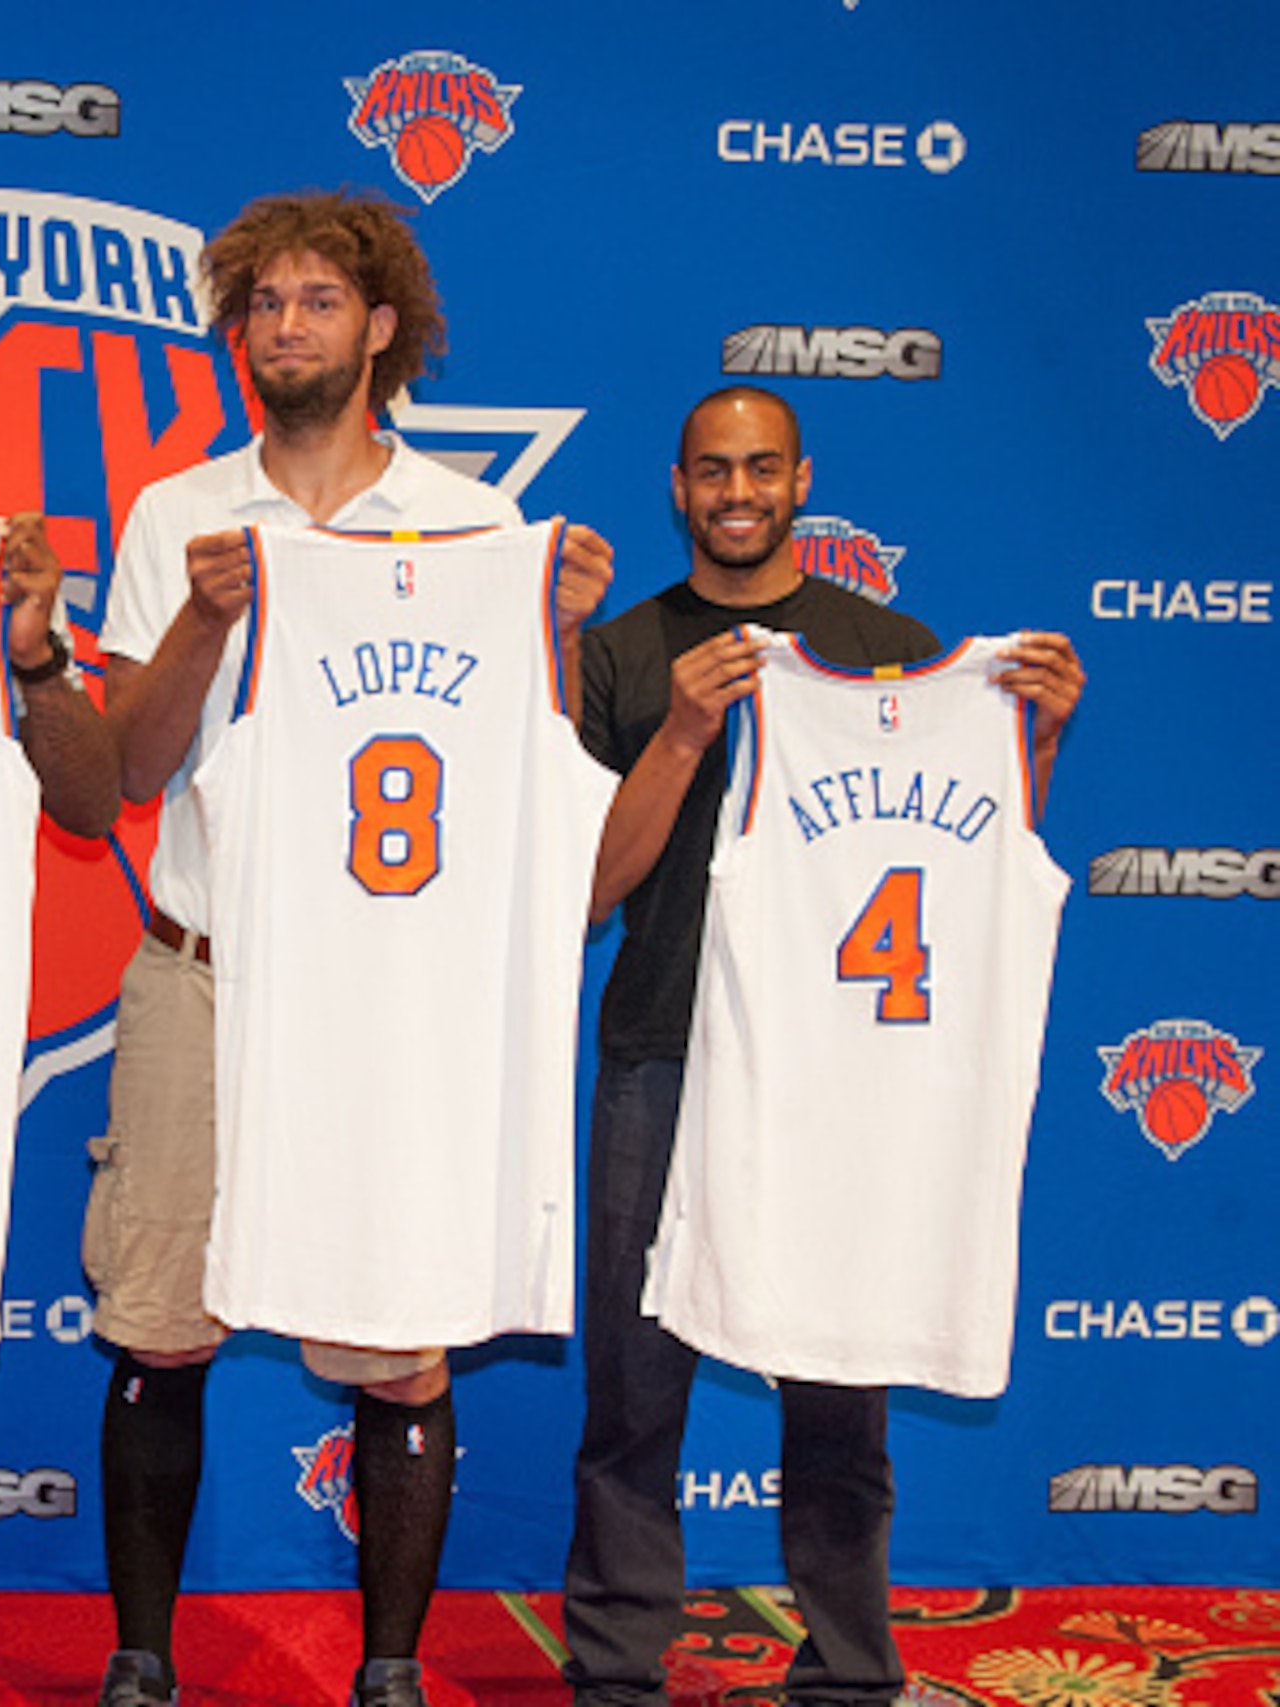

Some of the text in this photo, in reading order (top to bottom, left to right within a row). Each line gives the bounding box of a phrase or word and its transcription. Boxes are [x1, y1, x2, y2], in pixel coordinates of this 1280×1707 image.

[355, 68, 507, 132] KNICKS
[718, 120, 907, 166] CHASE
[1188, 121, 1280, 175] MS
[774, 324, 942, 380] MSG
[1091, 579, 1274, 623] CHASE
[318, 639, 479, 707] LOPEZ
[346, 732, 445, 897] 8
[788, 767, 998, 843] AFFLALO
[836, 866, 931, 1025] 4
[1107, 1036, 1248, 1094] KNICKS
[1045, 1300, 1222, 1339] CHASE
[674, 1468, 782, 1509] HAS
[1096, 1464, 1259, 1516] MSG
